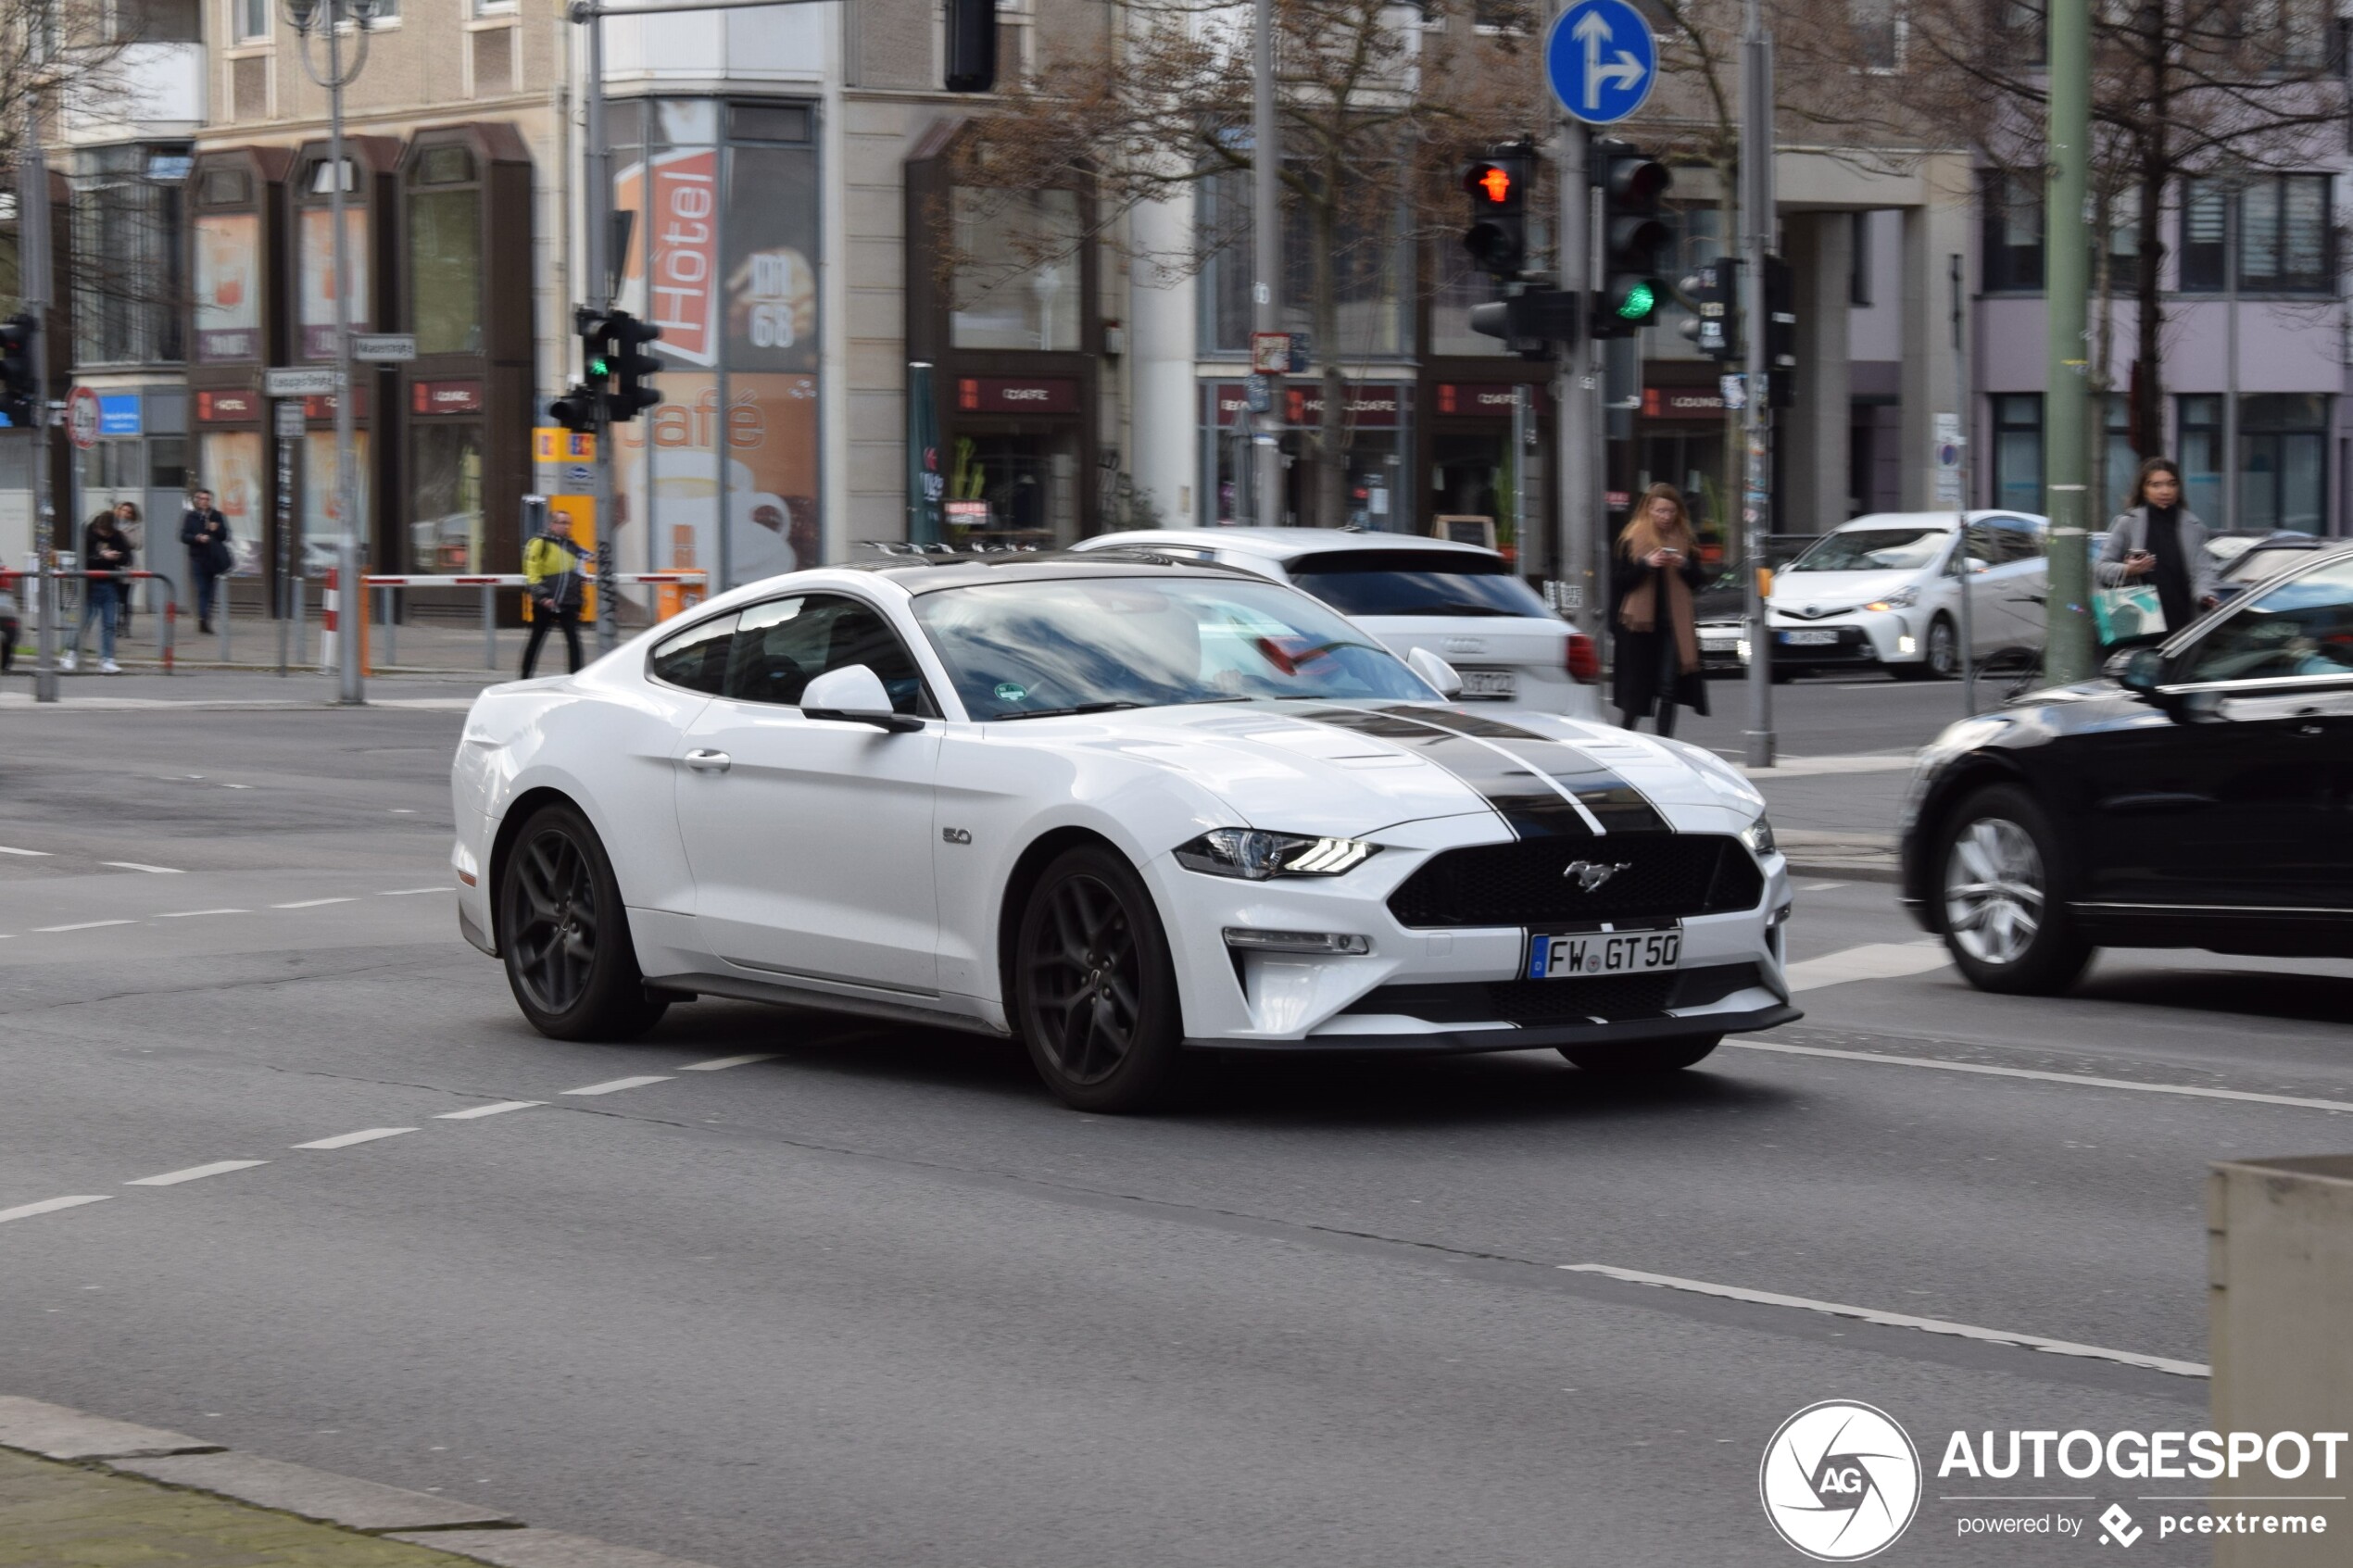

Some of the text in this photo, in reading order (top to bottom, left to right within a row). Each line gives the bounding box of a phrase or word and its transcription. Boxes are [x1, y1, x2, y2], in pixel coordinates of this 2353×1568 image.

[650, 171, 713, 331] Hotel
[749, 305, 795, 348] 68
[1002, 388, 1050, 400] CAFE
[1670, 396, 1724, 408] LOUNG
[1548, 935, 1680, 972] FW GT 50
